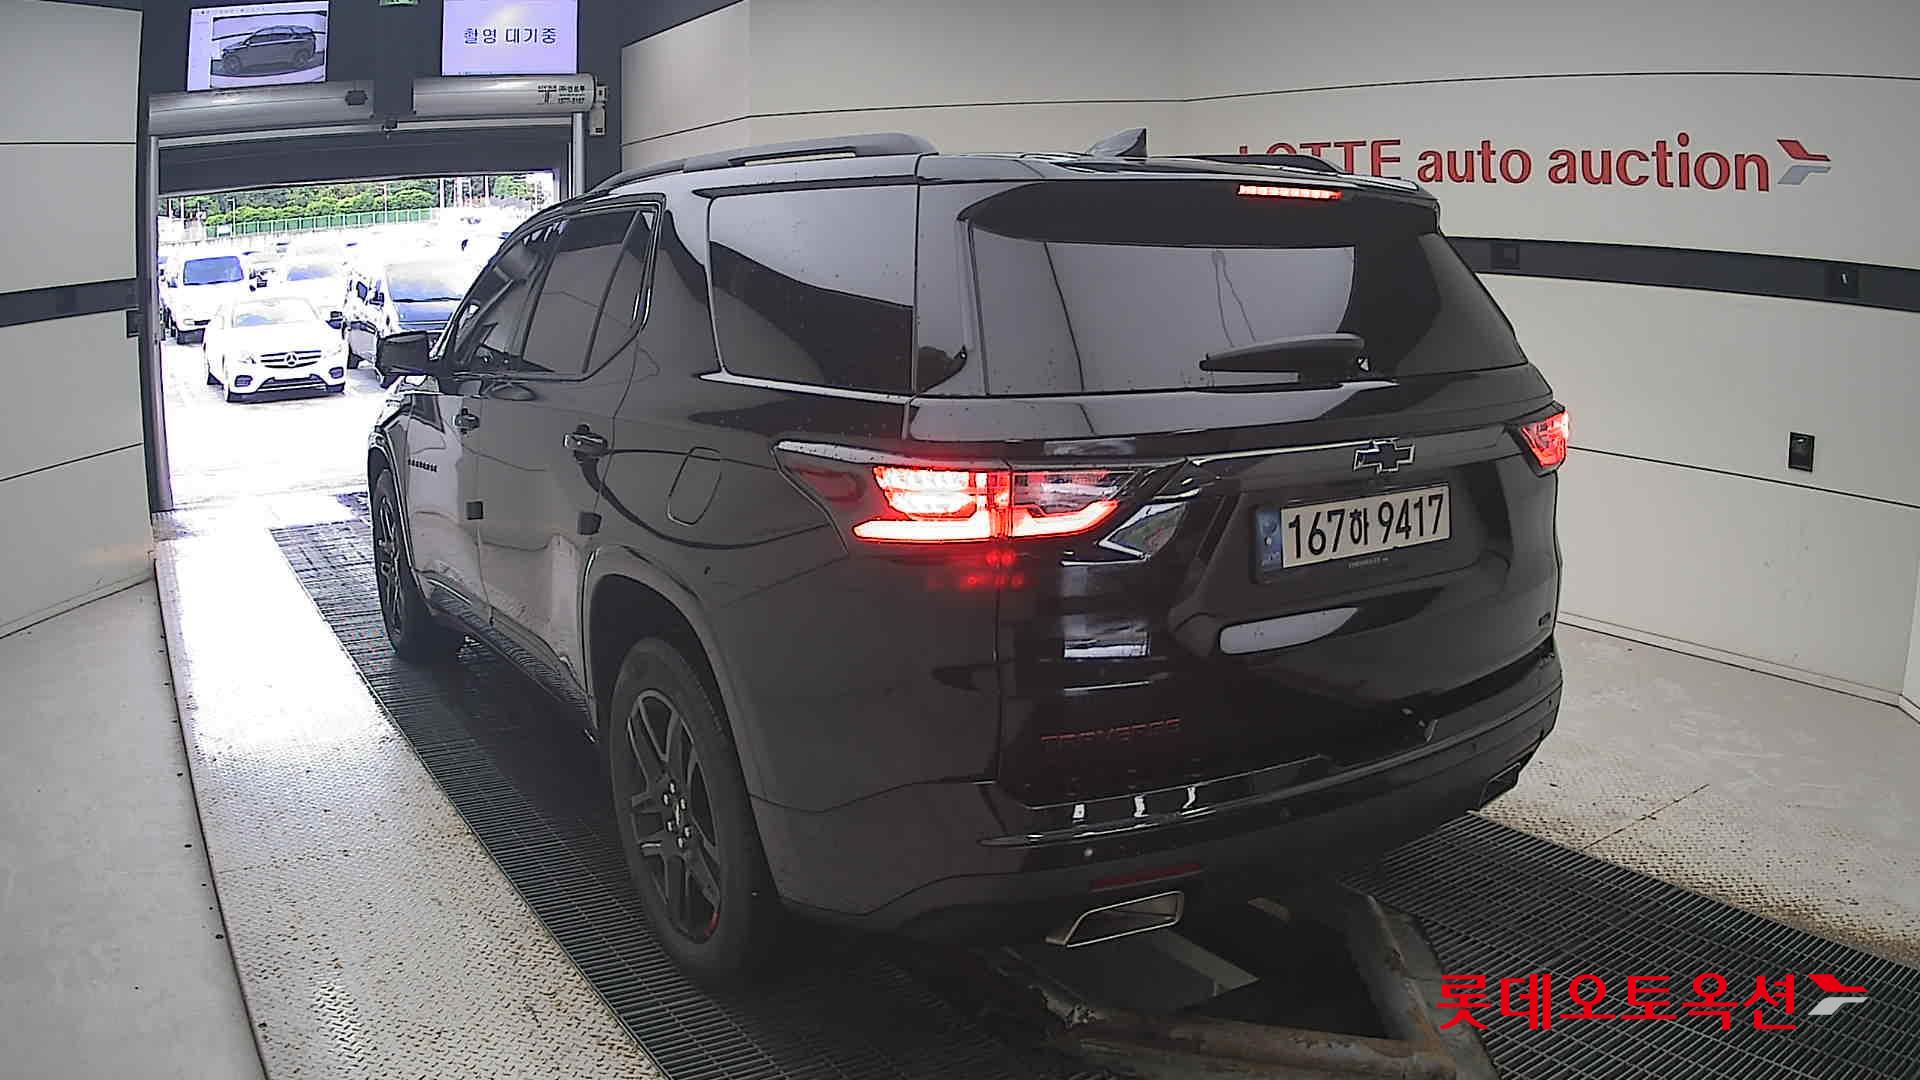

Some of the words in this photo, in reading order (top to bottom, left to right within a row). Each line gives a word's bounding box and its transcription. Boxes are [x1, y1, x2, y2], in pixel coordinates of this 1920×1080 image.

[505, 27, 558, 45] 대기중
[1418, 140, 1532, 184] auto
[1548, 132, 1771, 192] auction
[1288, 507, 1370, 560] 167하
[1377, 493, 1445, 545] 9417
